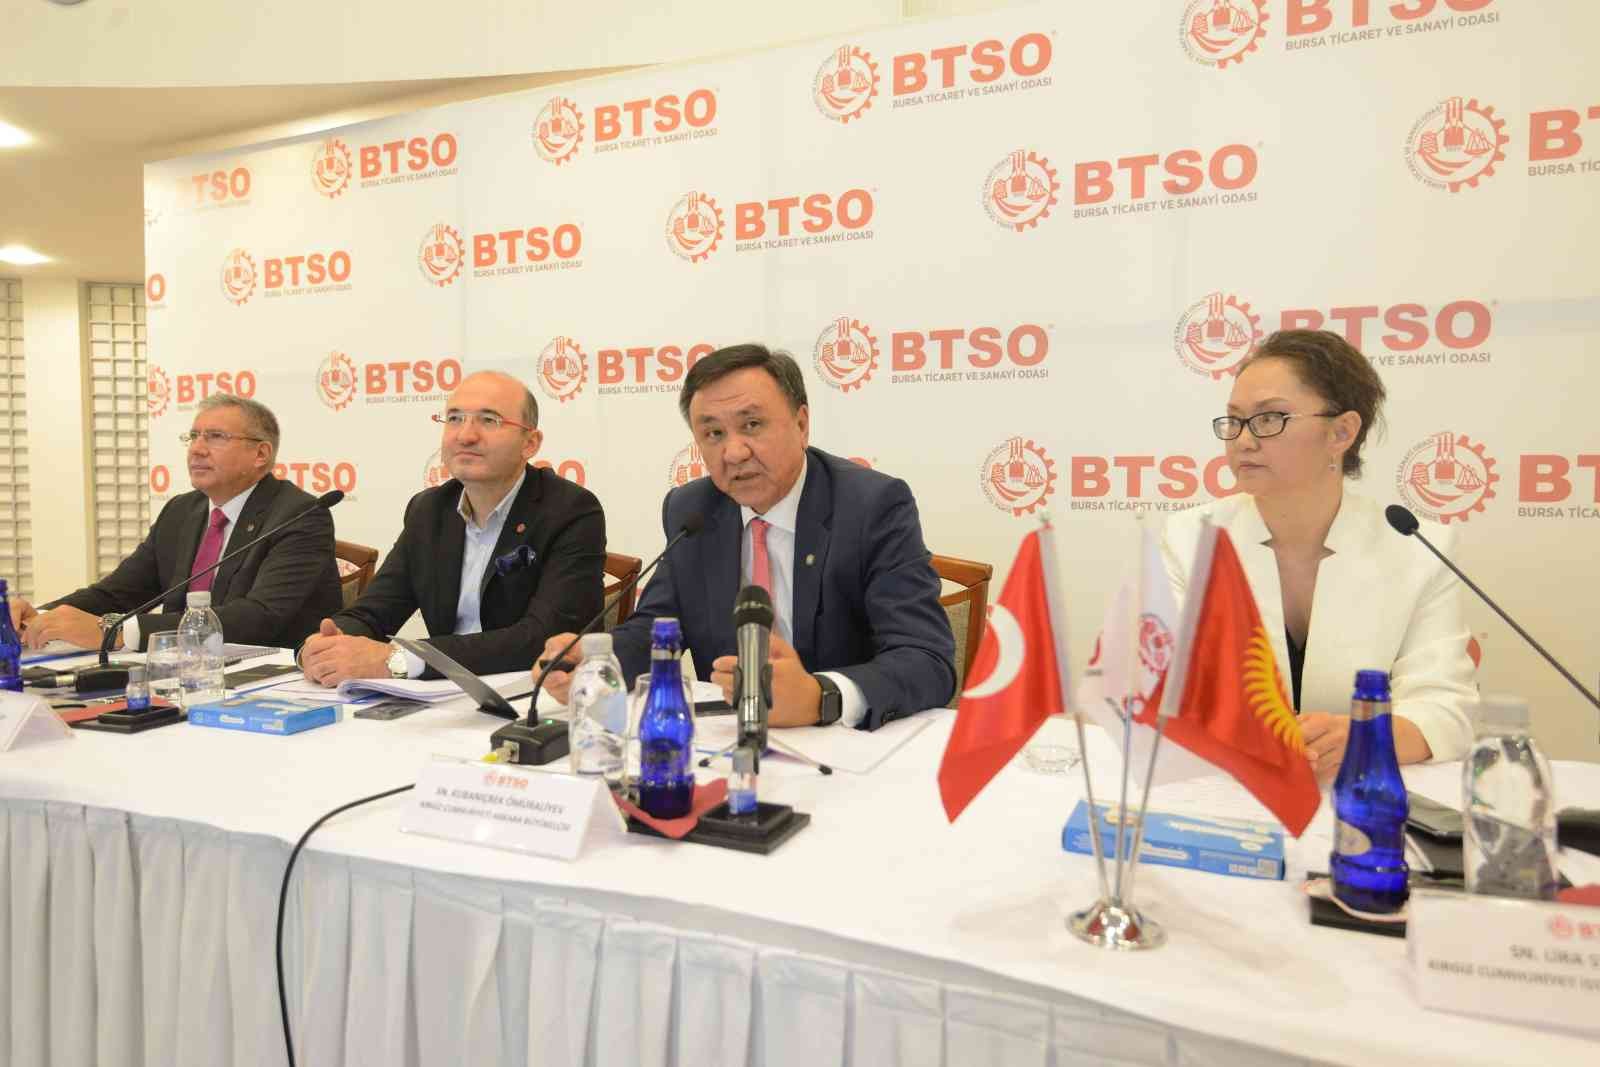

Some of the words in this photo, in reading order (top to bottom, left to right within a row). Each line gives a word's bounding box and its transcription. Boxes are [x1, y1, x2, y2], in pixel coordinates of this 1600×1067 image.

[1285, 36, 1326, 51] BURSA
[1329, 26, 1383, 45] TİCARET
[1386, 25, 1402, 37] VE
[1405, 15, 1454, 34] SANAYİ
[1457, 12, 1500, 27] ODASI
[892, 33, 1053, 96] BTSO
[892, 96, 924, 108] BURSA
[967, 88, 980, 97] VE
[1020, 77, 1052, 90] ODASI
[594, 89, 717, 142] BTSO
[359, 132, 458, 178] BTSO
[1528, 162, 1575, 176] BURSA
[1074, 144, 1258, 205] BTSO
[736, 189, 874, 241] BTSO
[1073, 206, 1109, 219] BURSA
[1112, 200, 1157, 215] TİCARET
[1159, 199, 1174, 210] VE
[1175, 192, 1219, 208] SANAYİ
[1222, 192, 1257, 205] ODASI
[473, 223, 582, 267] BTSO
[800, 237, 812, 246] VE
[264, 250, 351, 289] BTSO
[892, 323, 1049, 372] BTSO
[1378, 354, 1395, 366] VE
[1398, 352, 1445, 366] SANAYİ
[1449, 351, 1491, 365] ODASI
[176, 370, 256, 403] BTSO
[365, 358, 462, 395] BTSO
[891, 373, 922, 384] BURSA
[966, 371, 978, 381] VE
[979, 368, 1015, 380] SANAYİ
[1018, 368, 1049, 379] ODASI
[1071, 500, 1106, 512] BURSA
[1155, 502, 1170, 511] VE
[1518, 506, 1564, 518] BURSA
